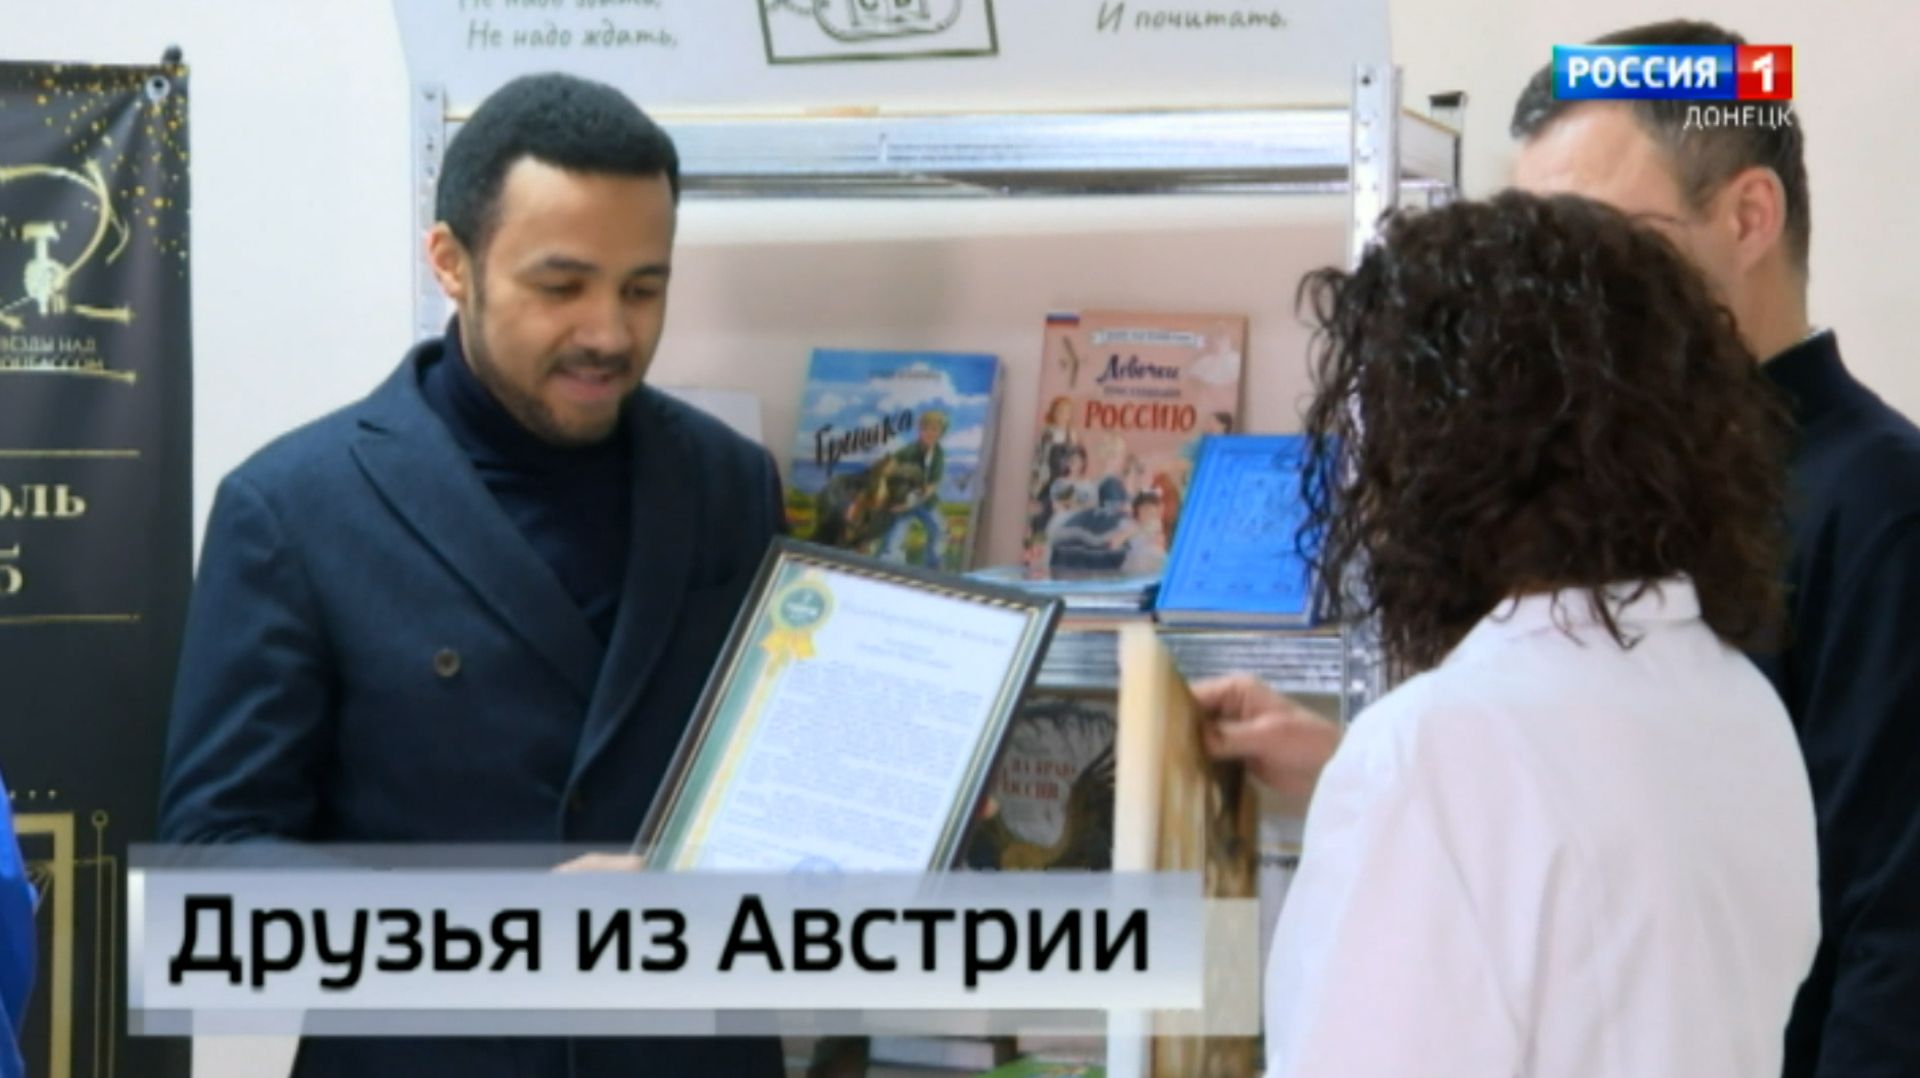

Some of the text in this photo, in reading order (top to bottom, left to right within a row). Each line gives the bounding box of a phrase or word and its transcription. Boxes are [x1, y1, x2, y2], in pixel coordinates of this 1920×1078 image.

[466, 18, 503, 50] Не
[512, 20, 573, 48] надо
[1083, 400, 1198, 432] РОССИЮ
